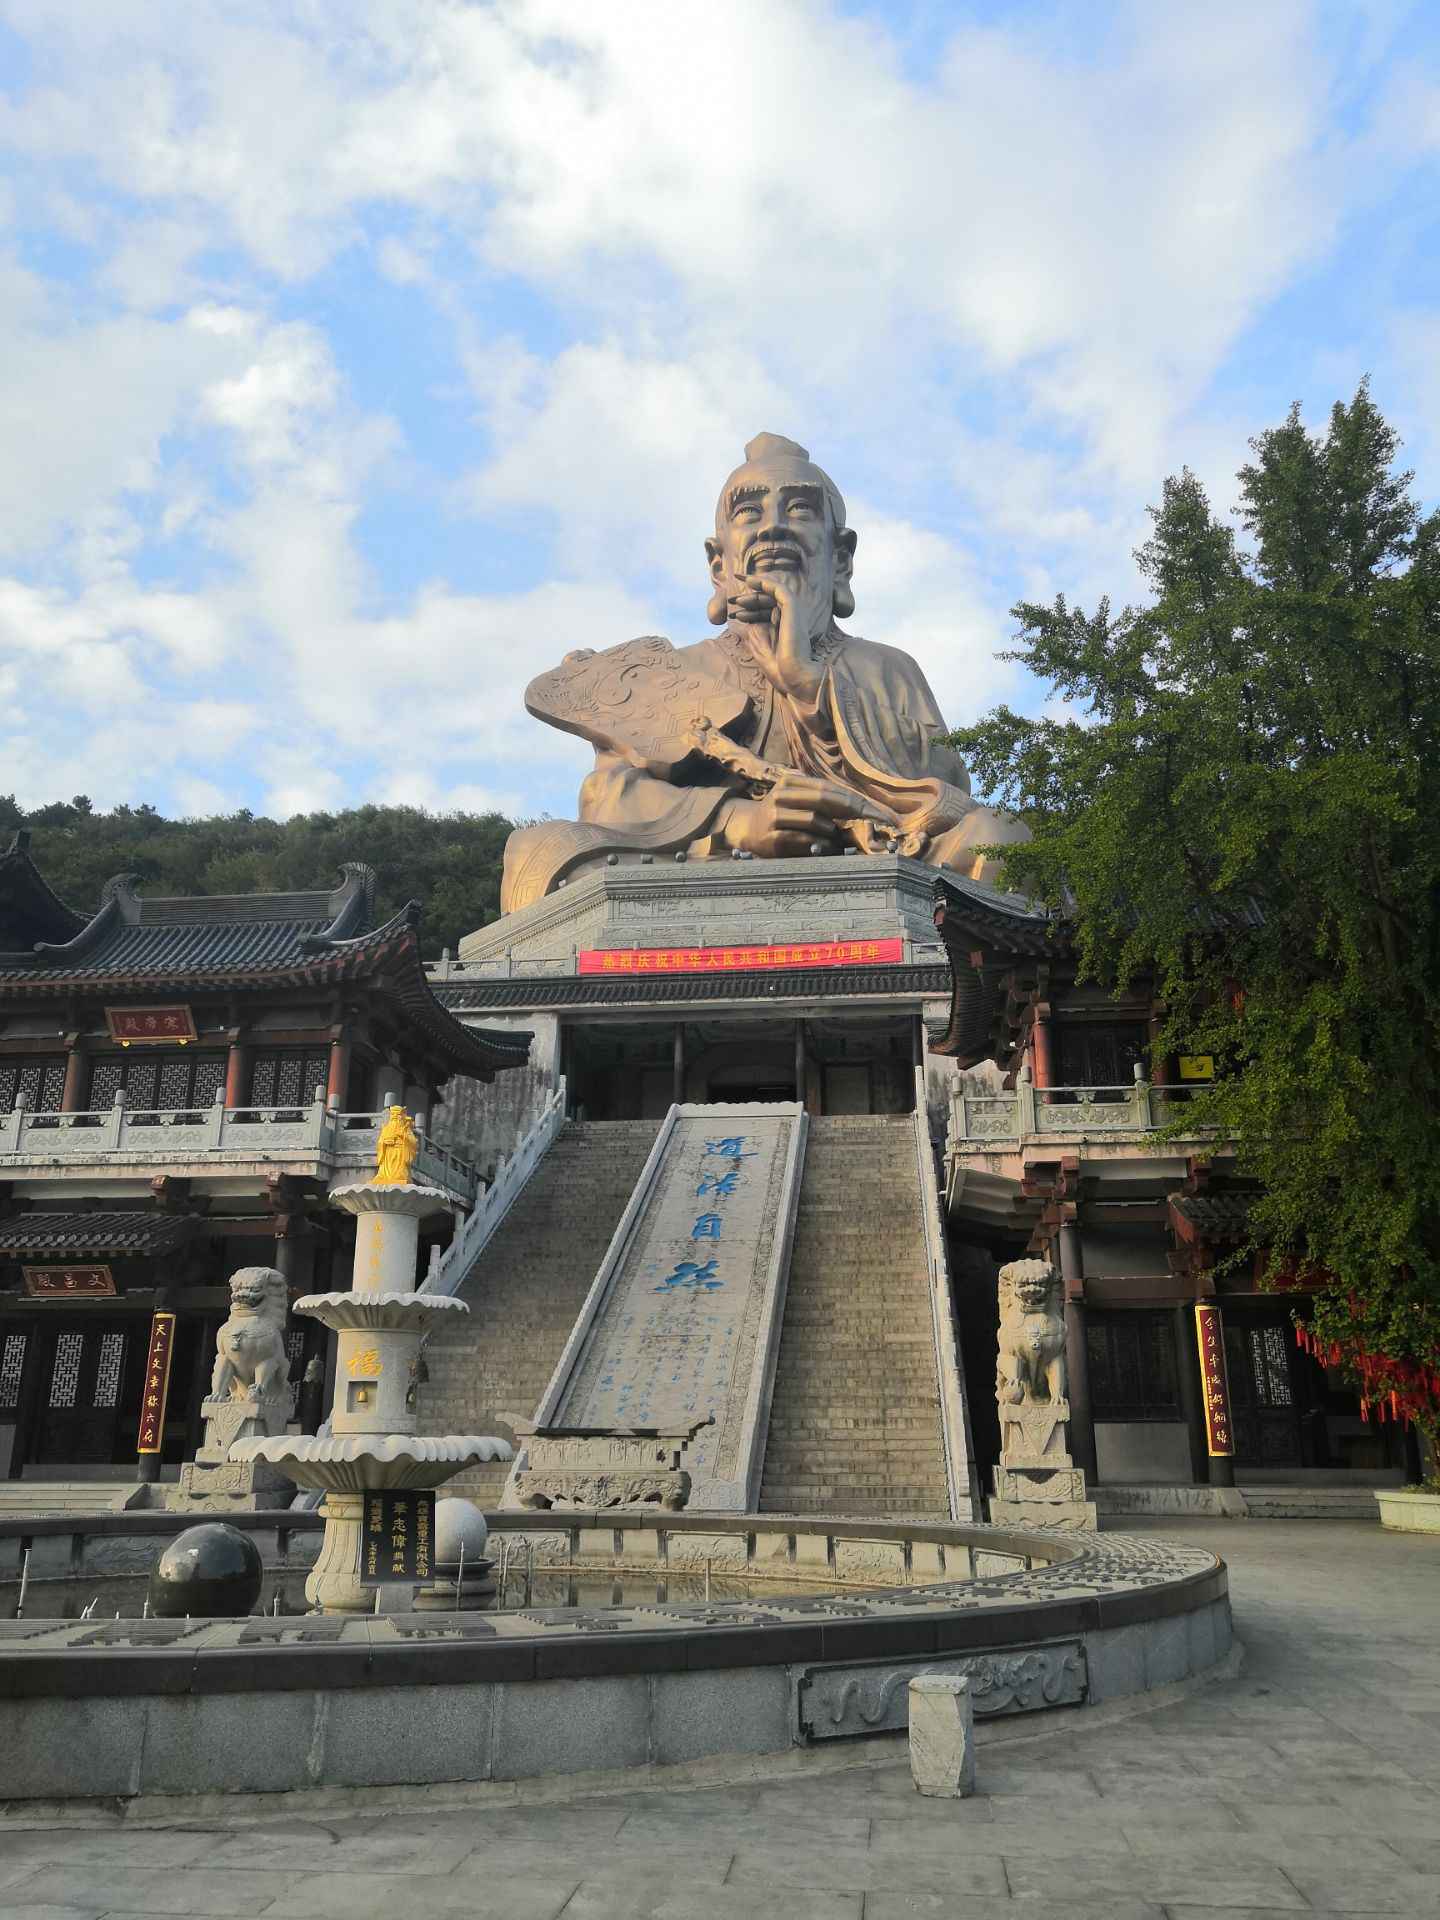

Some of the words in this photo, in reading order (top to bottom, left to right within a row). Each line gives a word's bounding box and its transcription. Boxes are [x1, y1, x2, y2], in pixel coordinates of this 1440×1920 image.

[601, 943, 880, 969] 热烈庆祝中华人民共和国成立70周年
[654, 1135, 759, 1294] 道法自然
